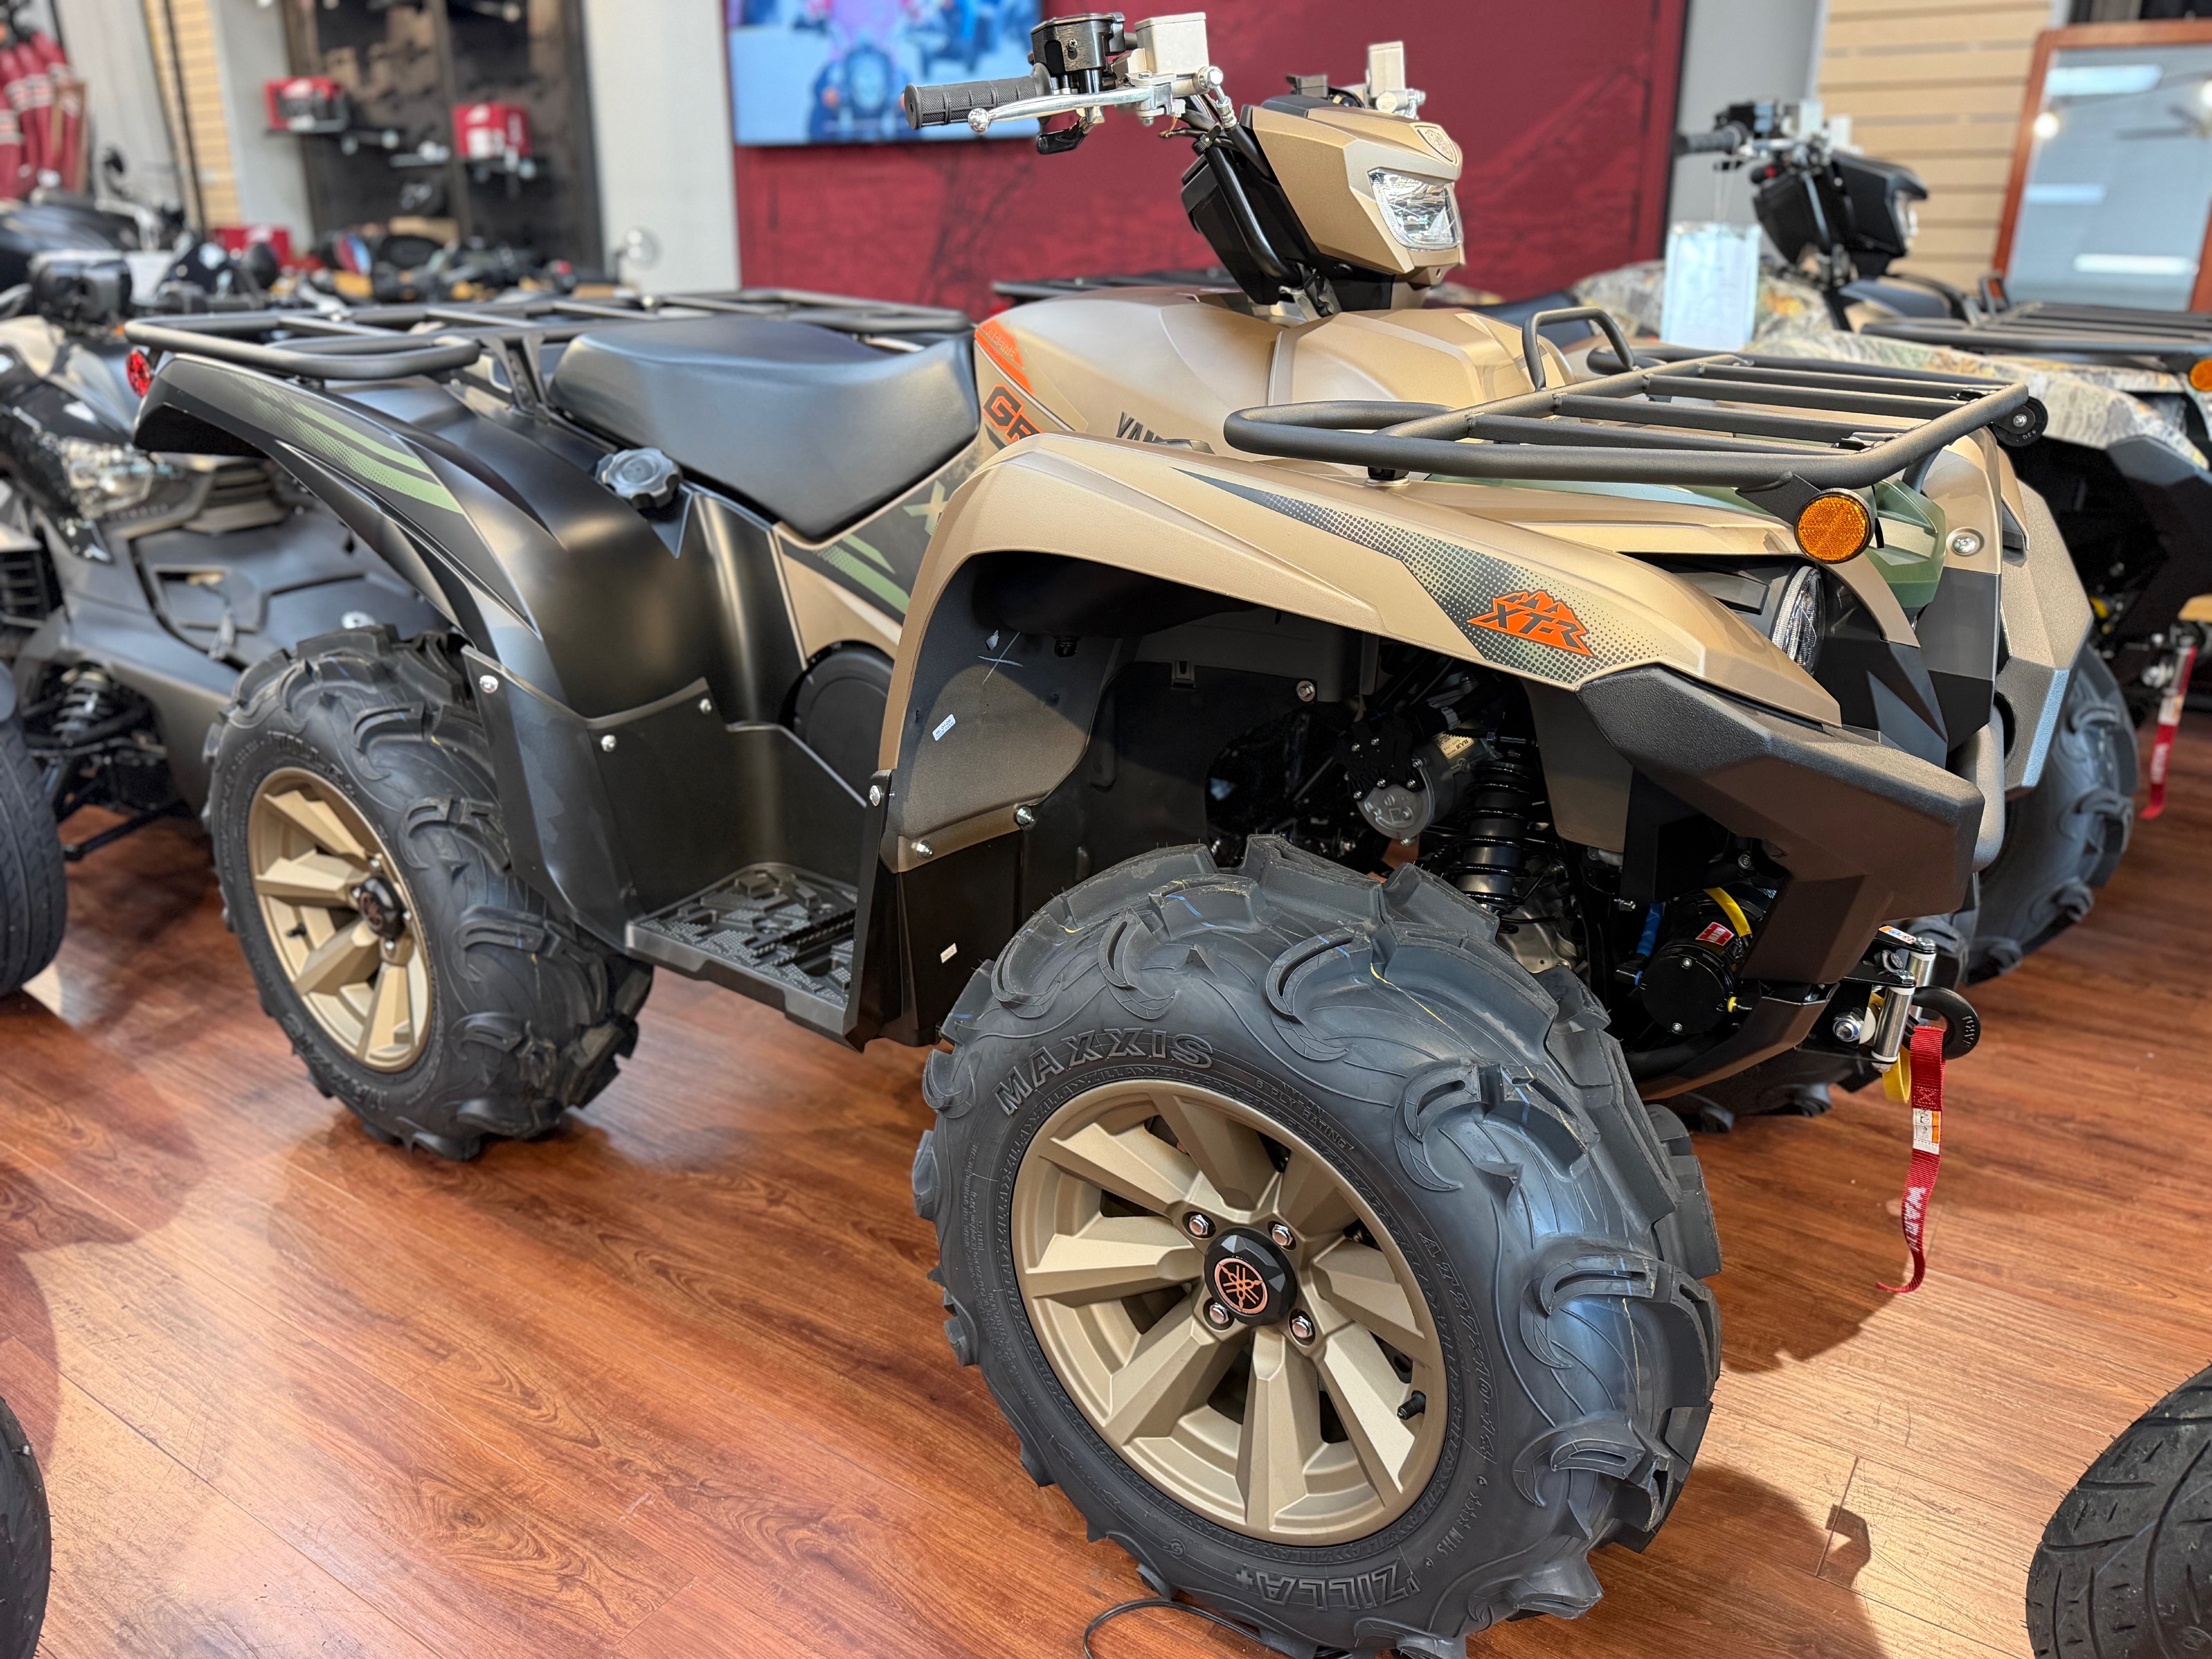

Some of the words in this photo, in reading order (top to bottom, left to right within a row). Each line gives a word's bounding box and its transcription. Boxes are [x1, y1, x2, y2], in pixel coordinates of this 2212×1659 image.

[985, 326, 1017, 360] XTREME
[1455, 739, 1469, 750] KYB
[997, 1027, 1213, 1115] MAXXIS
[1255, 1078, 1264, 1090] 6
[1271, 1087, 1296, 1107] PLY
[1303, 1108, 1348, 1149] RATING
[1435, 1526, 1464, 1555] NHS
